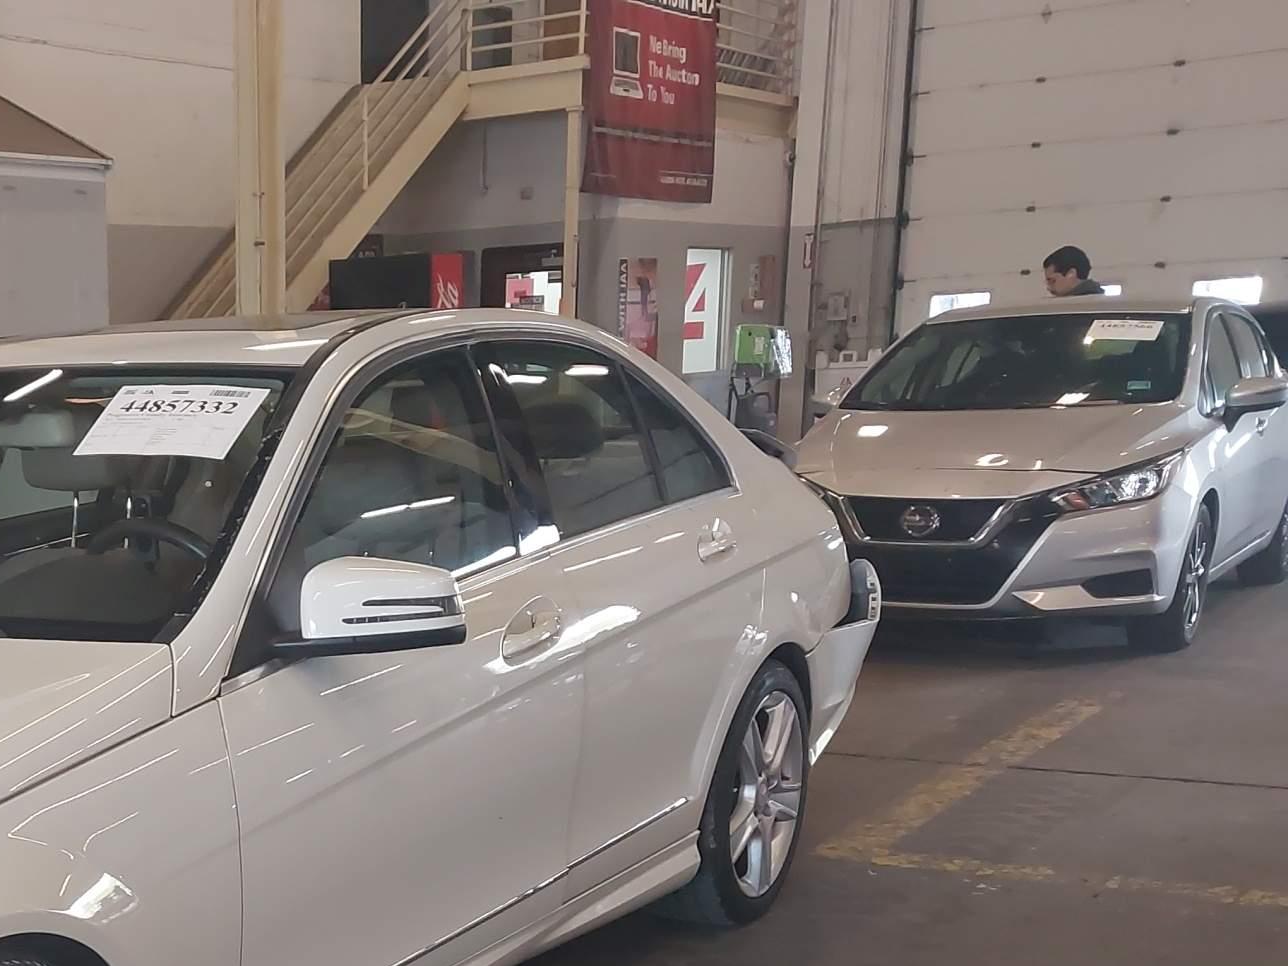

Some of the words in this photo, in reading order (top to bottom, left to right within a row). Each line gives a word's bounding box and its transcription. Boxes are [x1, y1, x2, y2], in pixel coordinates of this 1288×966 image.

[663, 39, 686, 64] Bring
[648, 60, 663, 79] The
[647, 84, 657, 102] To
[660, 86, 675, 104] You
[120, 399, 238, 414] 44857332
